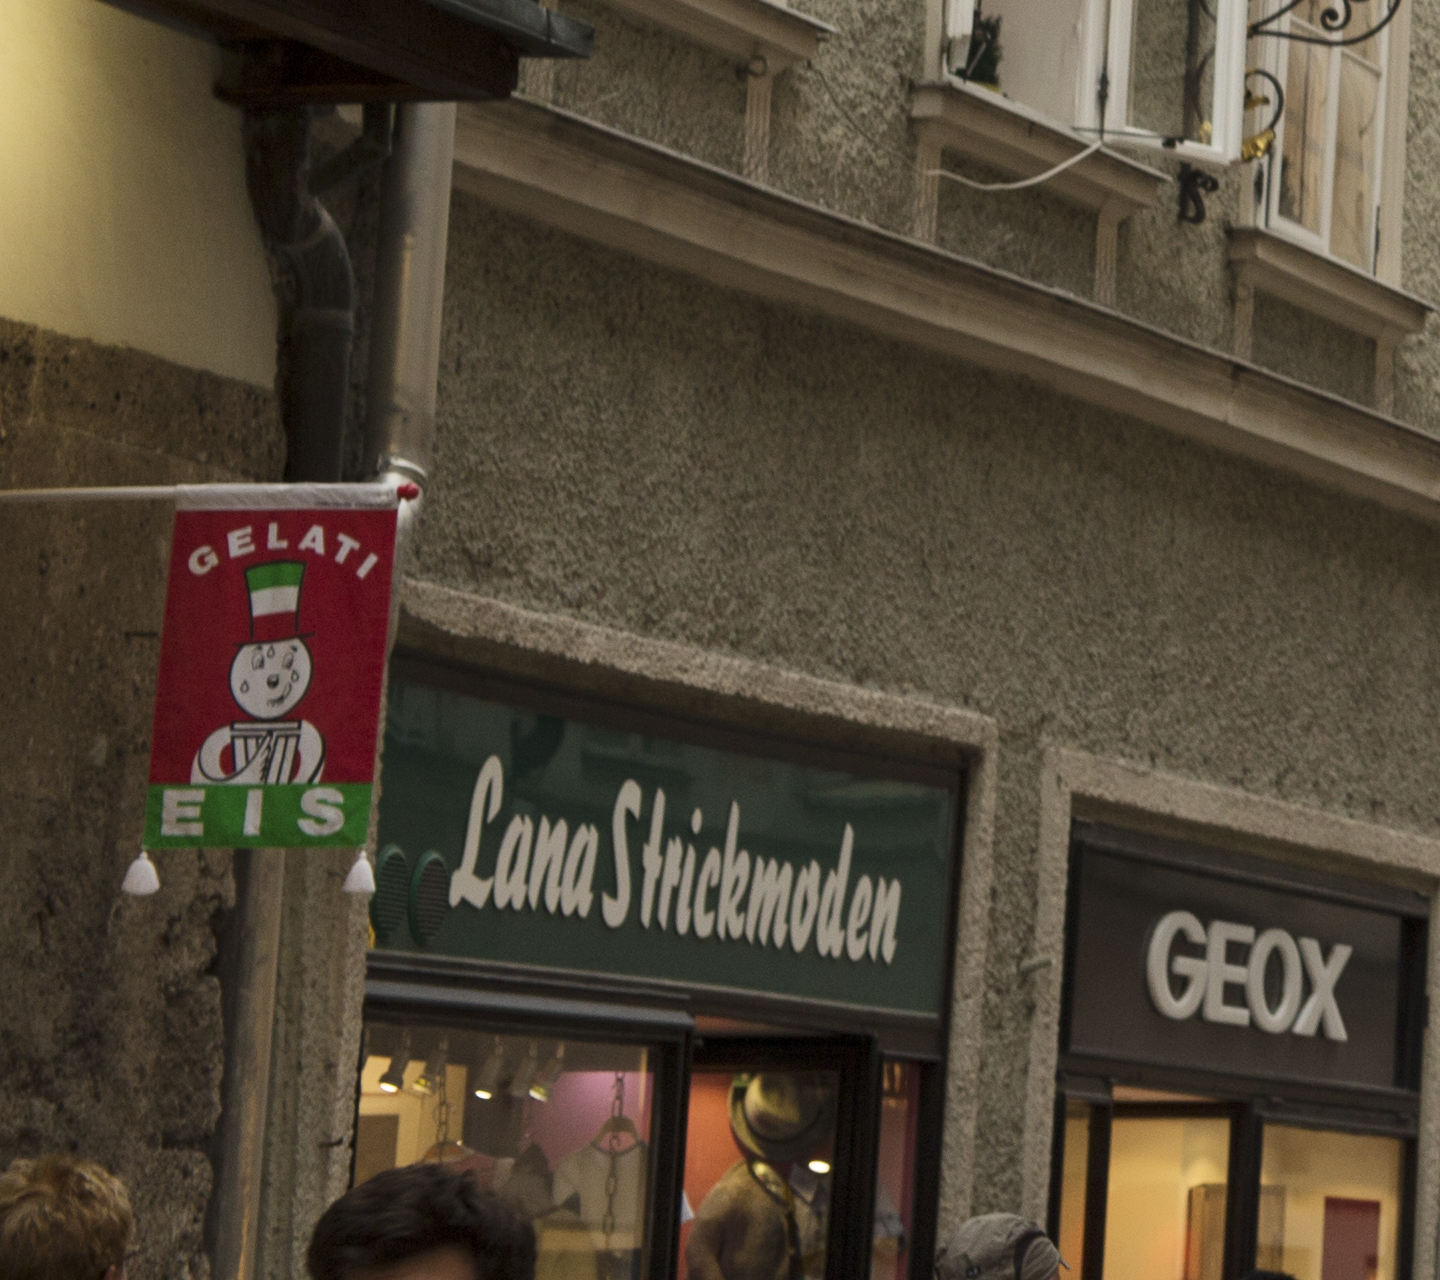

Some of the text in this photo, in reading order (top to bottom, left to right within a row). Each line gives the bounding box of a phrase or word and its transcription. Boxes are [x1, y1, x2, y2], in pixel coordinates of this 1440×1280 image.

[187, 522, 379, 580] GELATI
[159, 787, 347, 837] EIS
[449, 754, 903, 965] Lana Strickmoden
[1147, 910, 1353, 1042] GEOX
